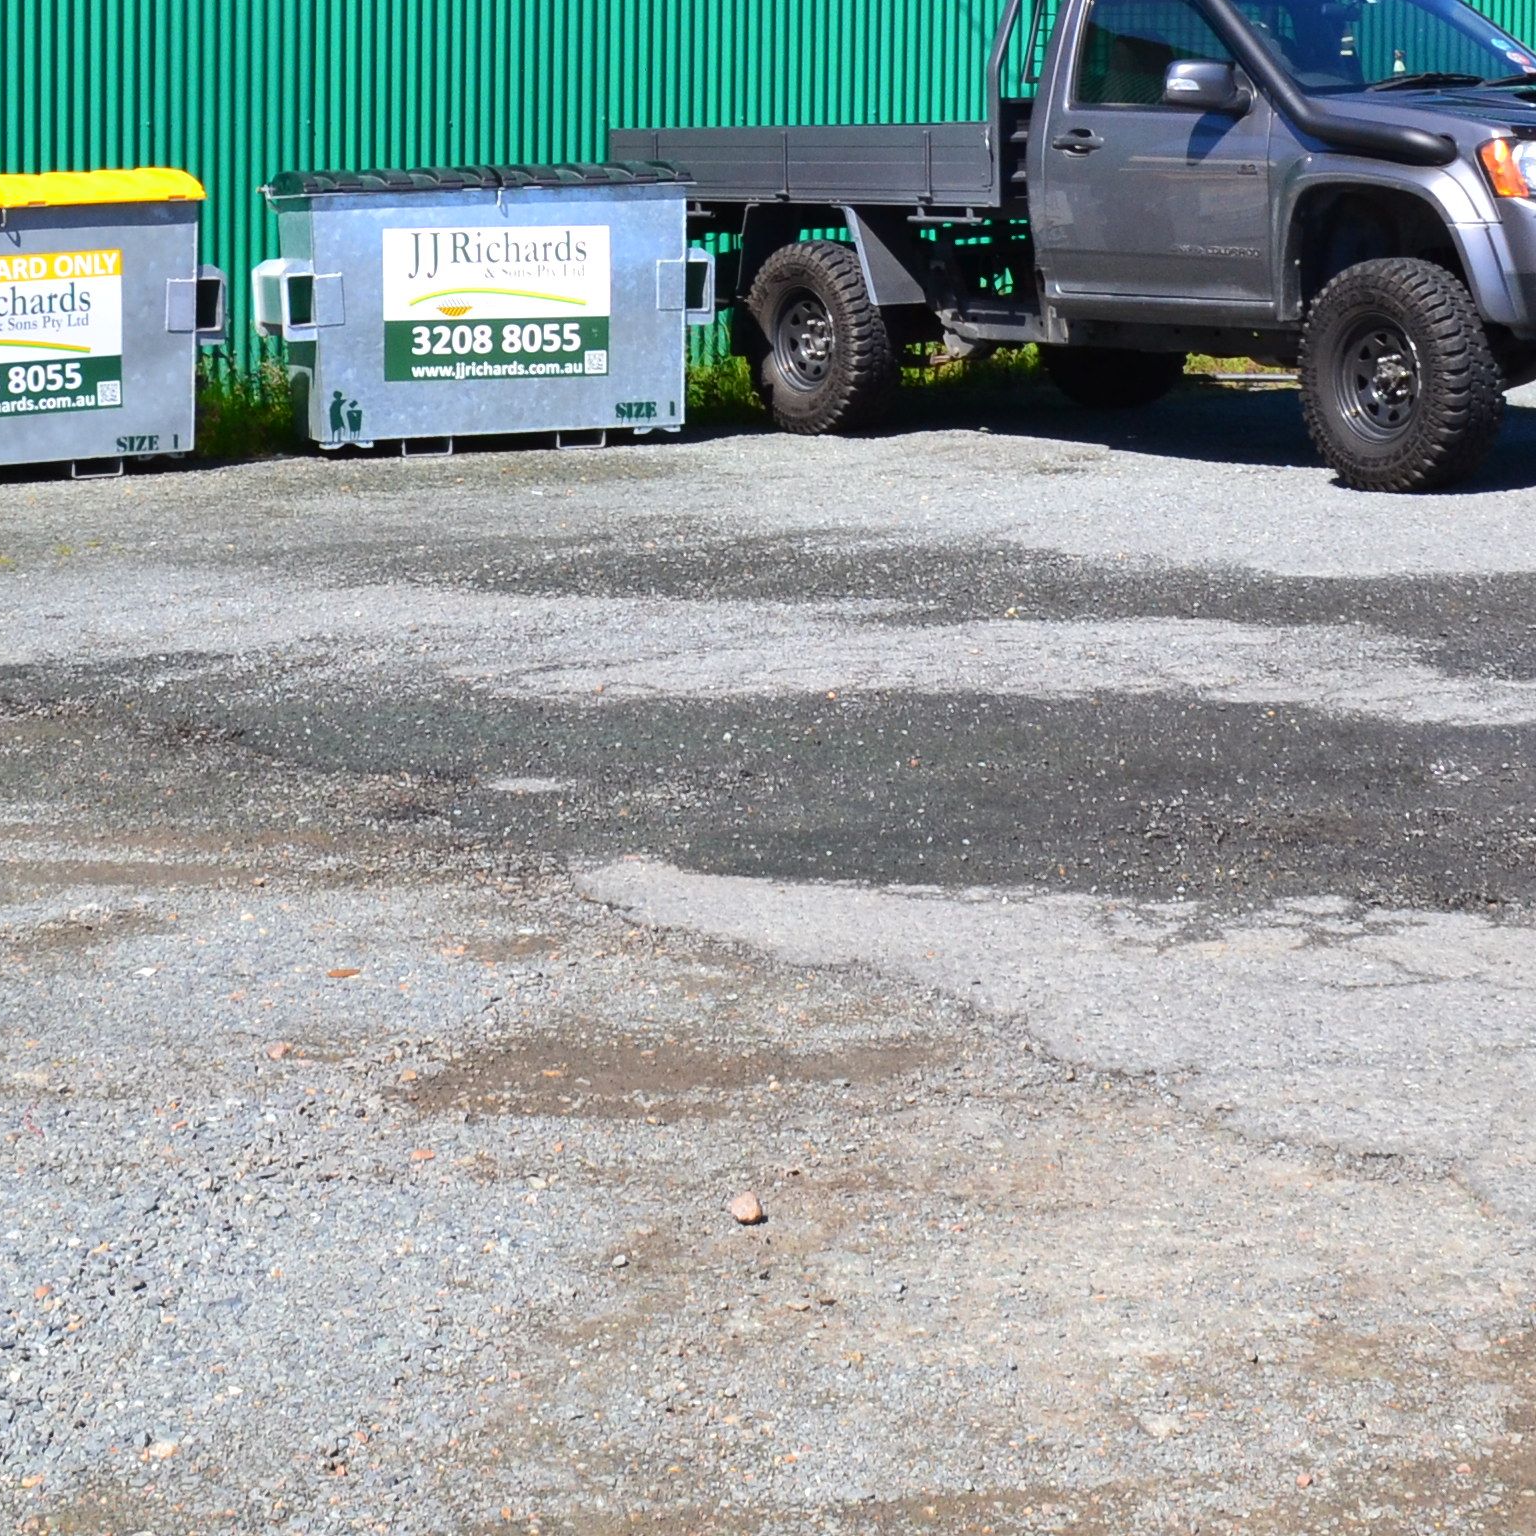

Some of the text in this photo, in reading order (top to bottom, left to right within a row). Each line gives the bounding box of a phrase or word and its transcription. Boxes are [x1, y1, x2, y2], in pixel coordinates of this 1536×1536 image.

[450, 231, 587, 264] Richards
[54, 252, 119, 277] ONLY
[8, 317, 38, 331] Sons
[42, 315, 63, 332] Pty
[67, 313, 90, 327] Ltd
[411, 322, 582, 355] 3208 8055
[8, 362, 83, 393] 8055
[411, 361, 583, 380] www.jjrichards.com.au
[615, 401, 657, 419] SIZE
[116, 434, 159, 452] SIZE
